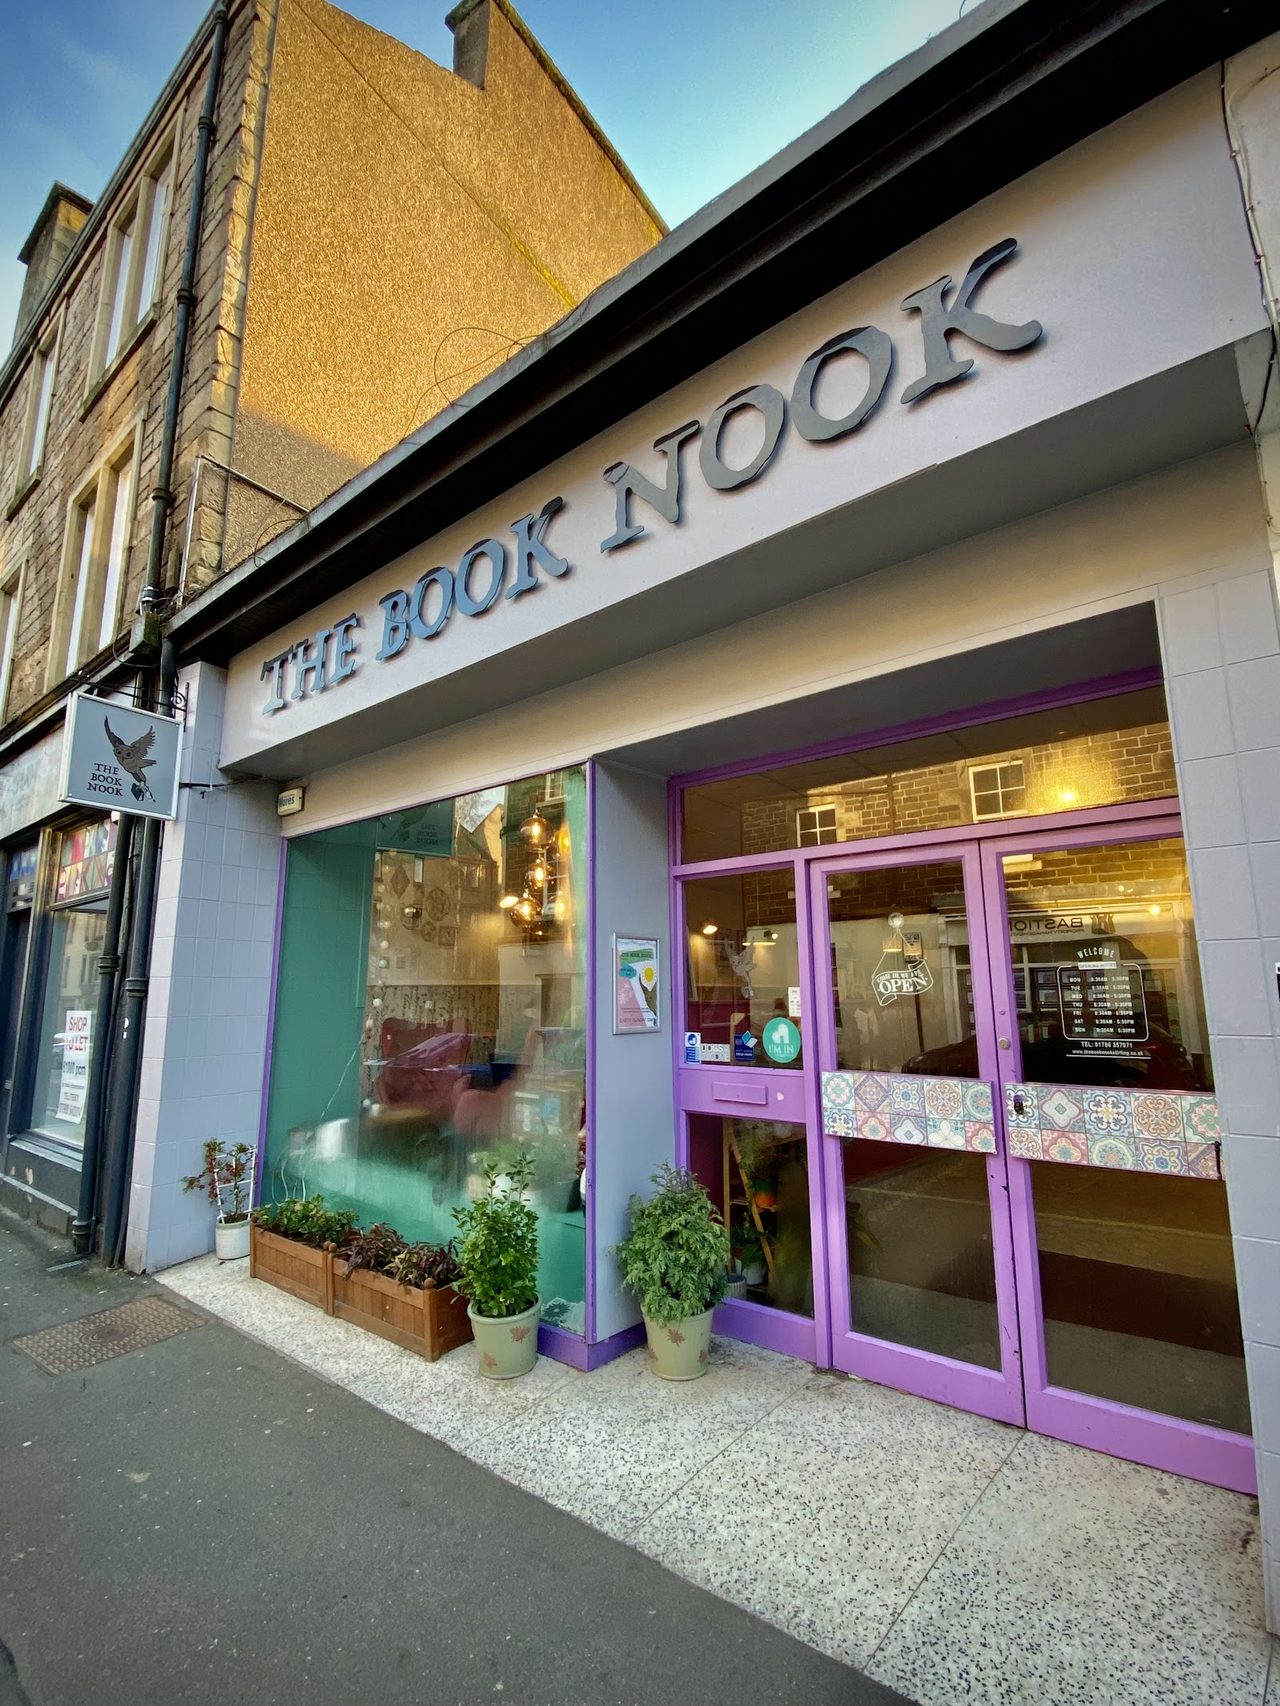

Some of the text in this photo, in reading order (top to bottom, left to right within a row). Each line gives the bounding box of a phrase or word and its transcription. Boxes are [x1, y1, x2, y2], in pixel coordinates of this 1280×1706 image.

[261, 237, 1043, 716] THE BOOK NOOK
[94, 763, 119, 775] THE
[91, 773, 122, 786] BOOK
[87, 782, 123, 796] NOOK
[1077, 947, 1115, 958] WELCOME
[878, 974, 927, 994] OPEN
[69, 1016, 88, 1031] SHOP
[75, 1035, 88, 1051] LET
[768, 1045, 794, 1054] I'M IN
